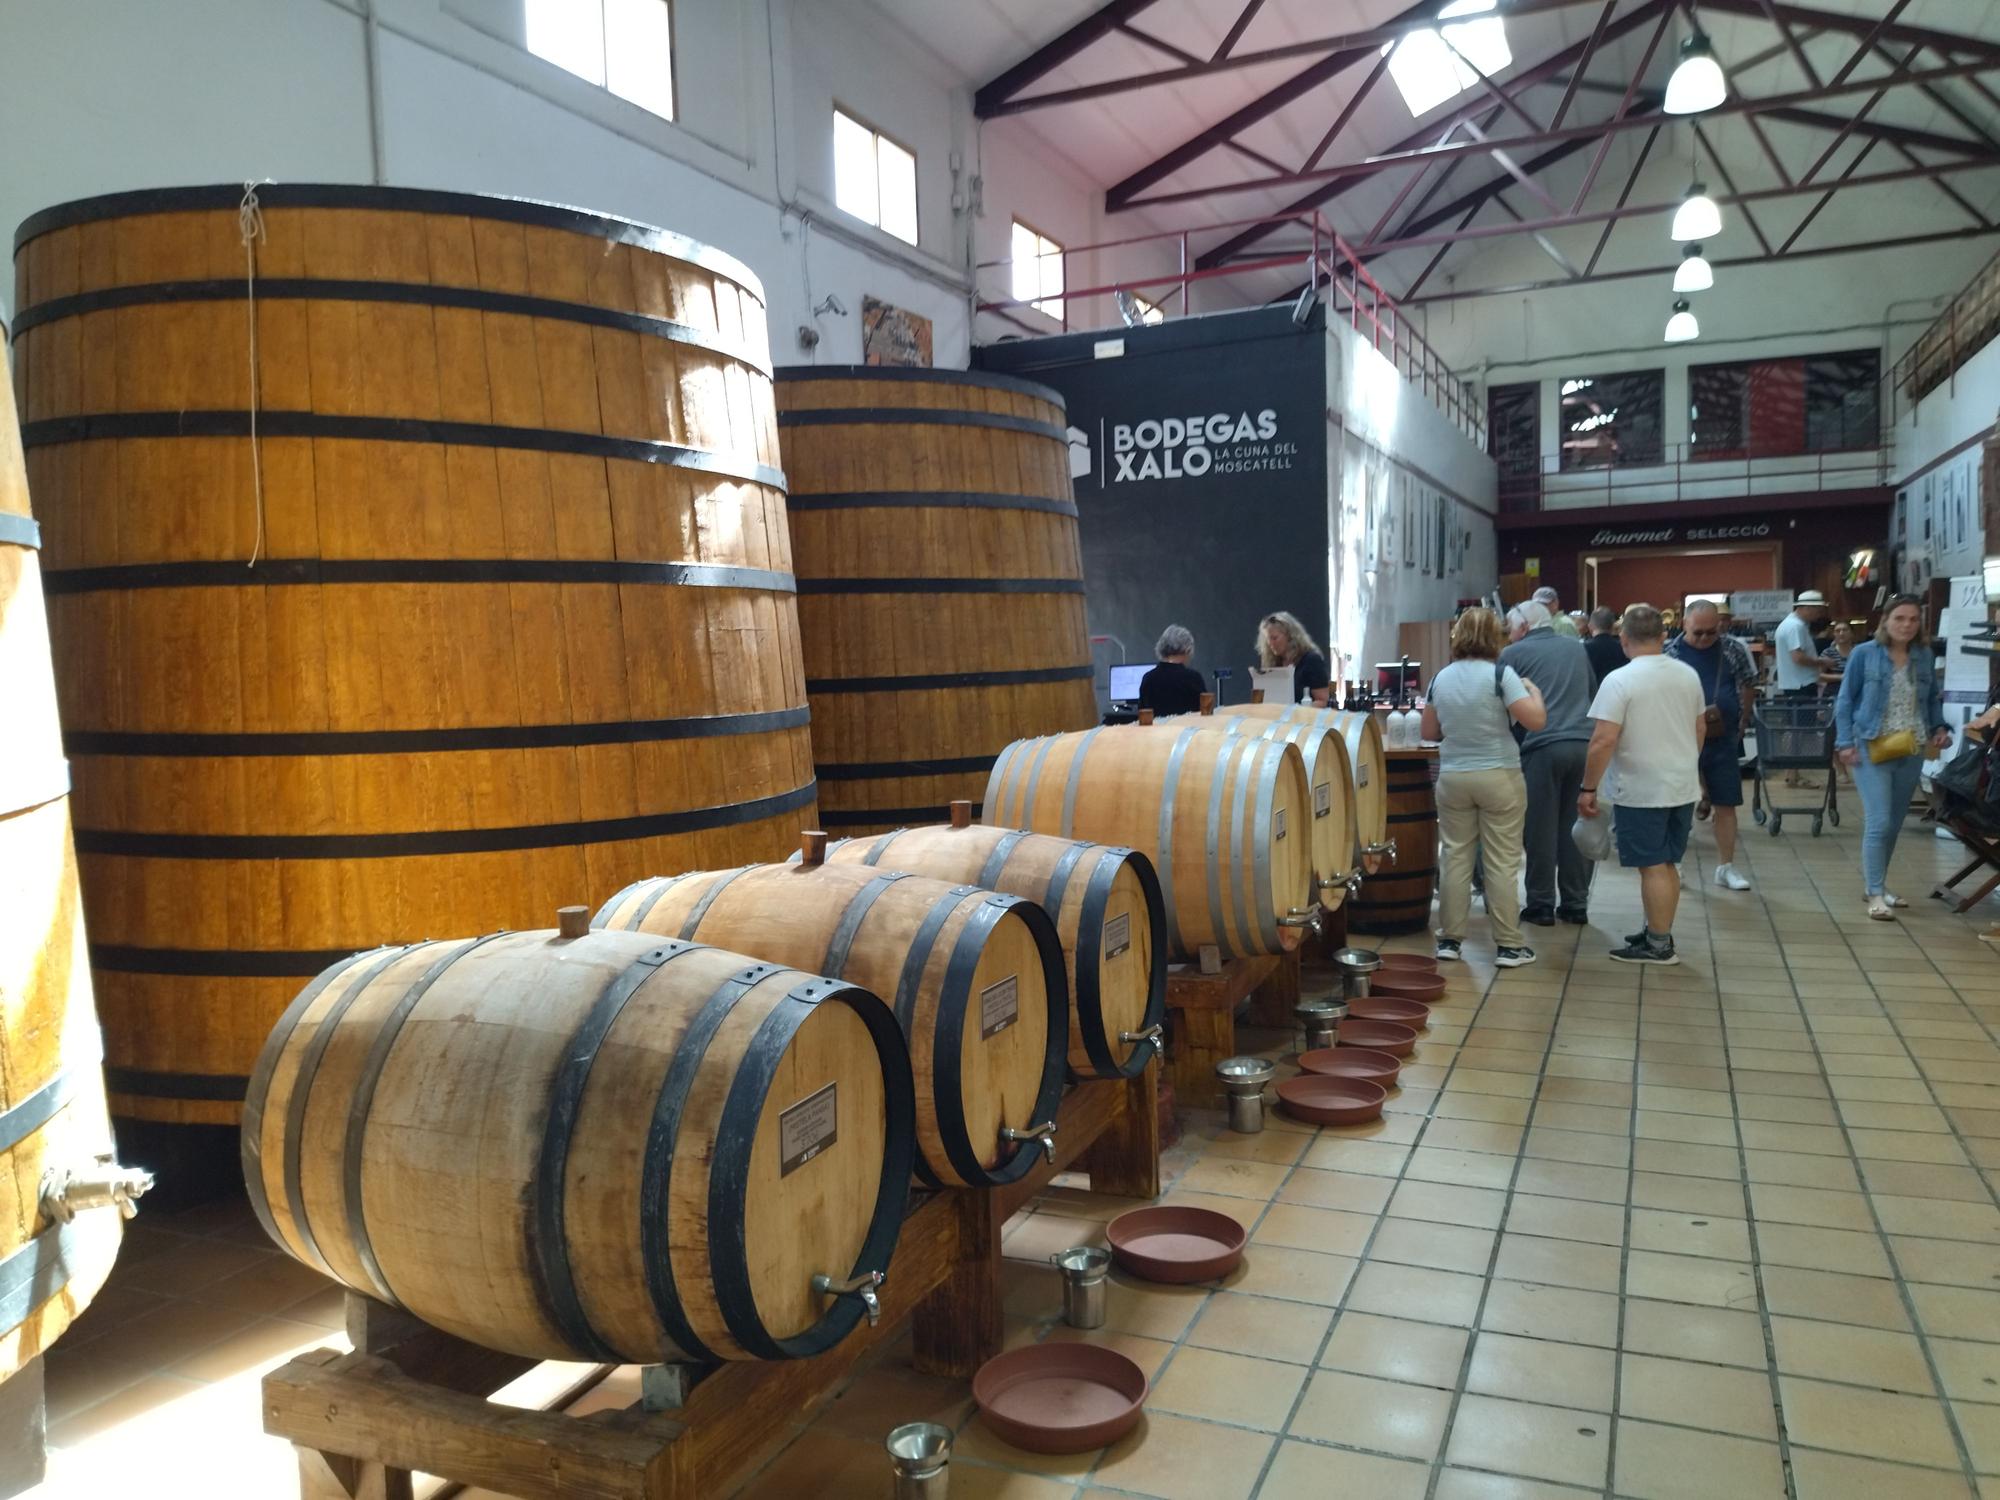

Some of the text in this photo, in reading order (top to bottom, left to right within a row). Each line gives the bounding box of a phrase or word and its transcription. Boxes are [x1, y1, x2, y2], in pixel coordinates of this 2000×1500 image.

[1114, 409, 1277, 452] BODEGAS
[1214, 442, 1299, 460] LA CUNA DEL
[1214, 457, 1292, 475] MOSCATELL
[1590, 523, 1770, 546] Gourmet SELECCIÓ
